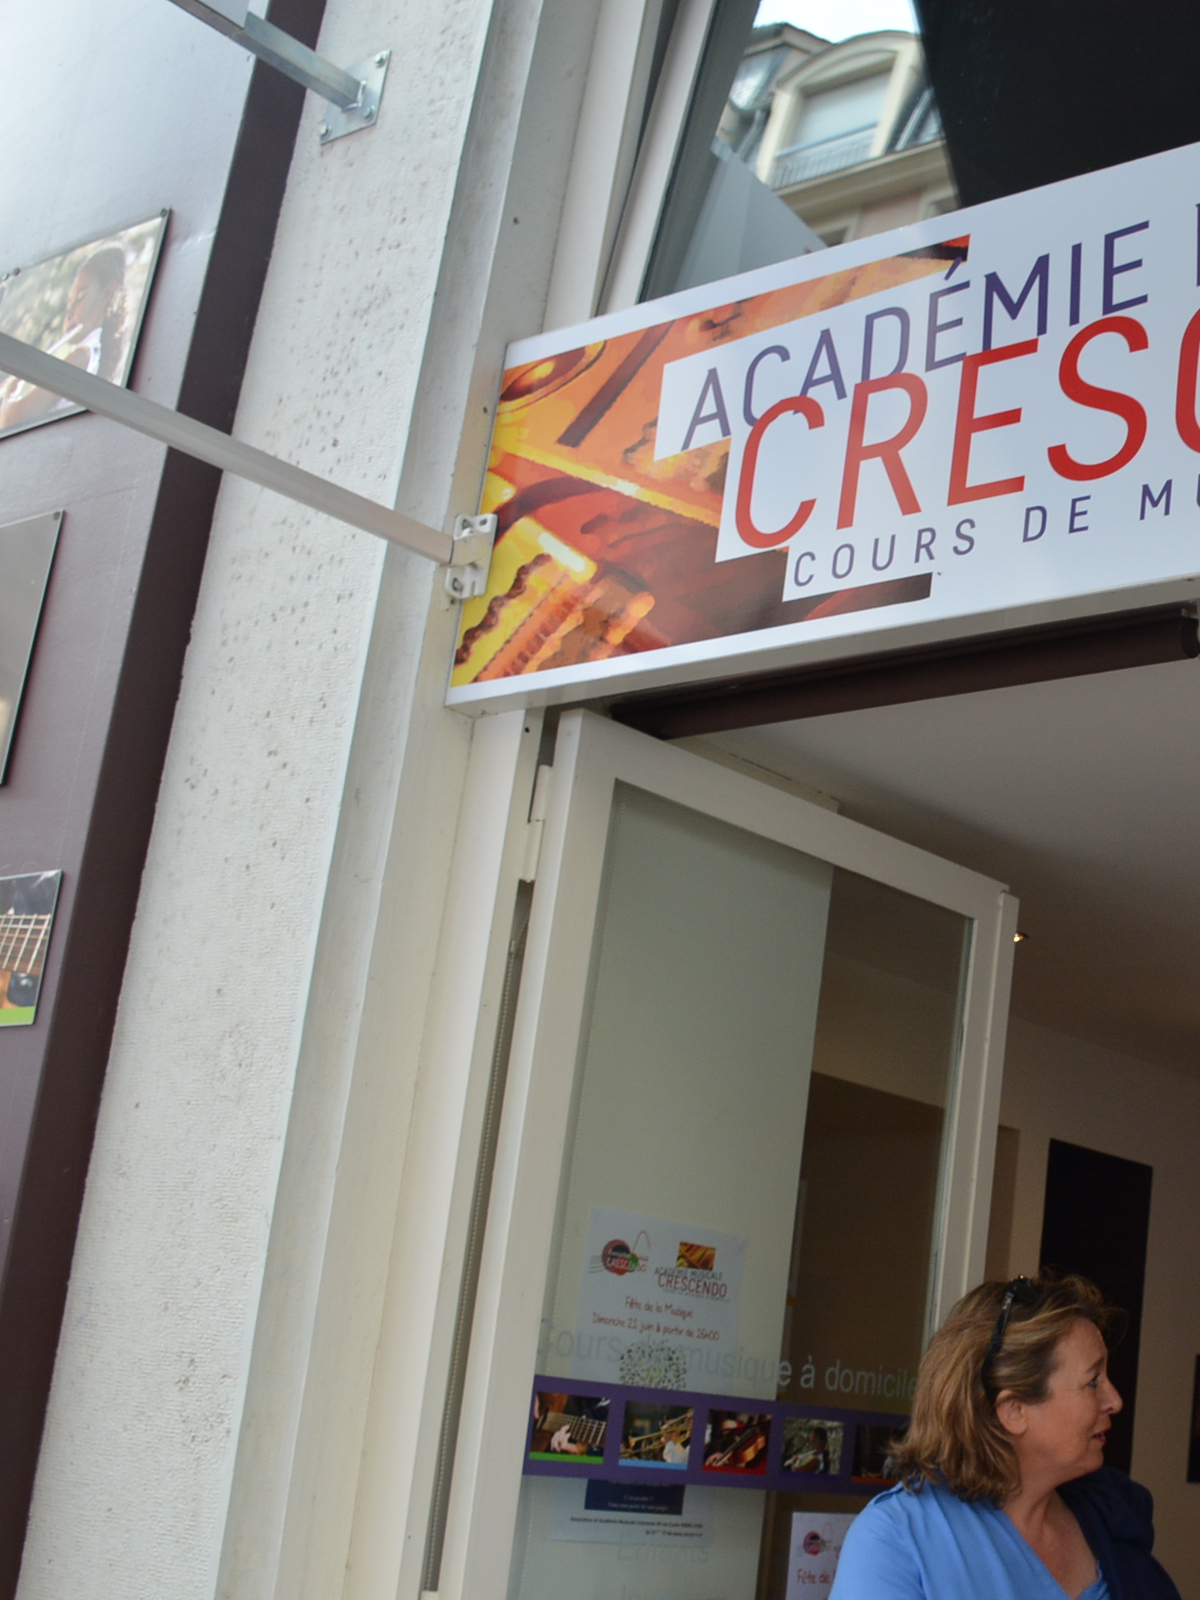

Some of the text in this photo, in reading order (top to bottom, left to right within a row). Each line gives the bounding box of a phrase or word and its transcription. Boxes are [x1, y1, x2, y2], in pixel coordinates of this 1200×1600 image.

[681, 221, 1150, 452] ACADÉMIE
[793, 518, 977, 587] COURS
[1022, 495, 1092, 543] DE
[624, 1295, 642, 1311] Fête
[657, 1272, 728, 1299] CRESCENDO
[592, 1311, 626, 1327] Dimanche
[627, 1317, 638, 1330] 21
[639, 1321, 655, 1334] juin
[662, 1325, 684, 1337] partir
[537, 1317, 622, 1363] Cours
[677, 1343, 792, 1389] musique
[800, 1354, 817, 1389] à
[824, 1359, 919, 1400] domicile
